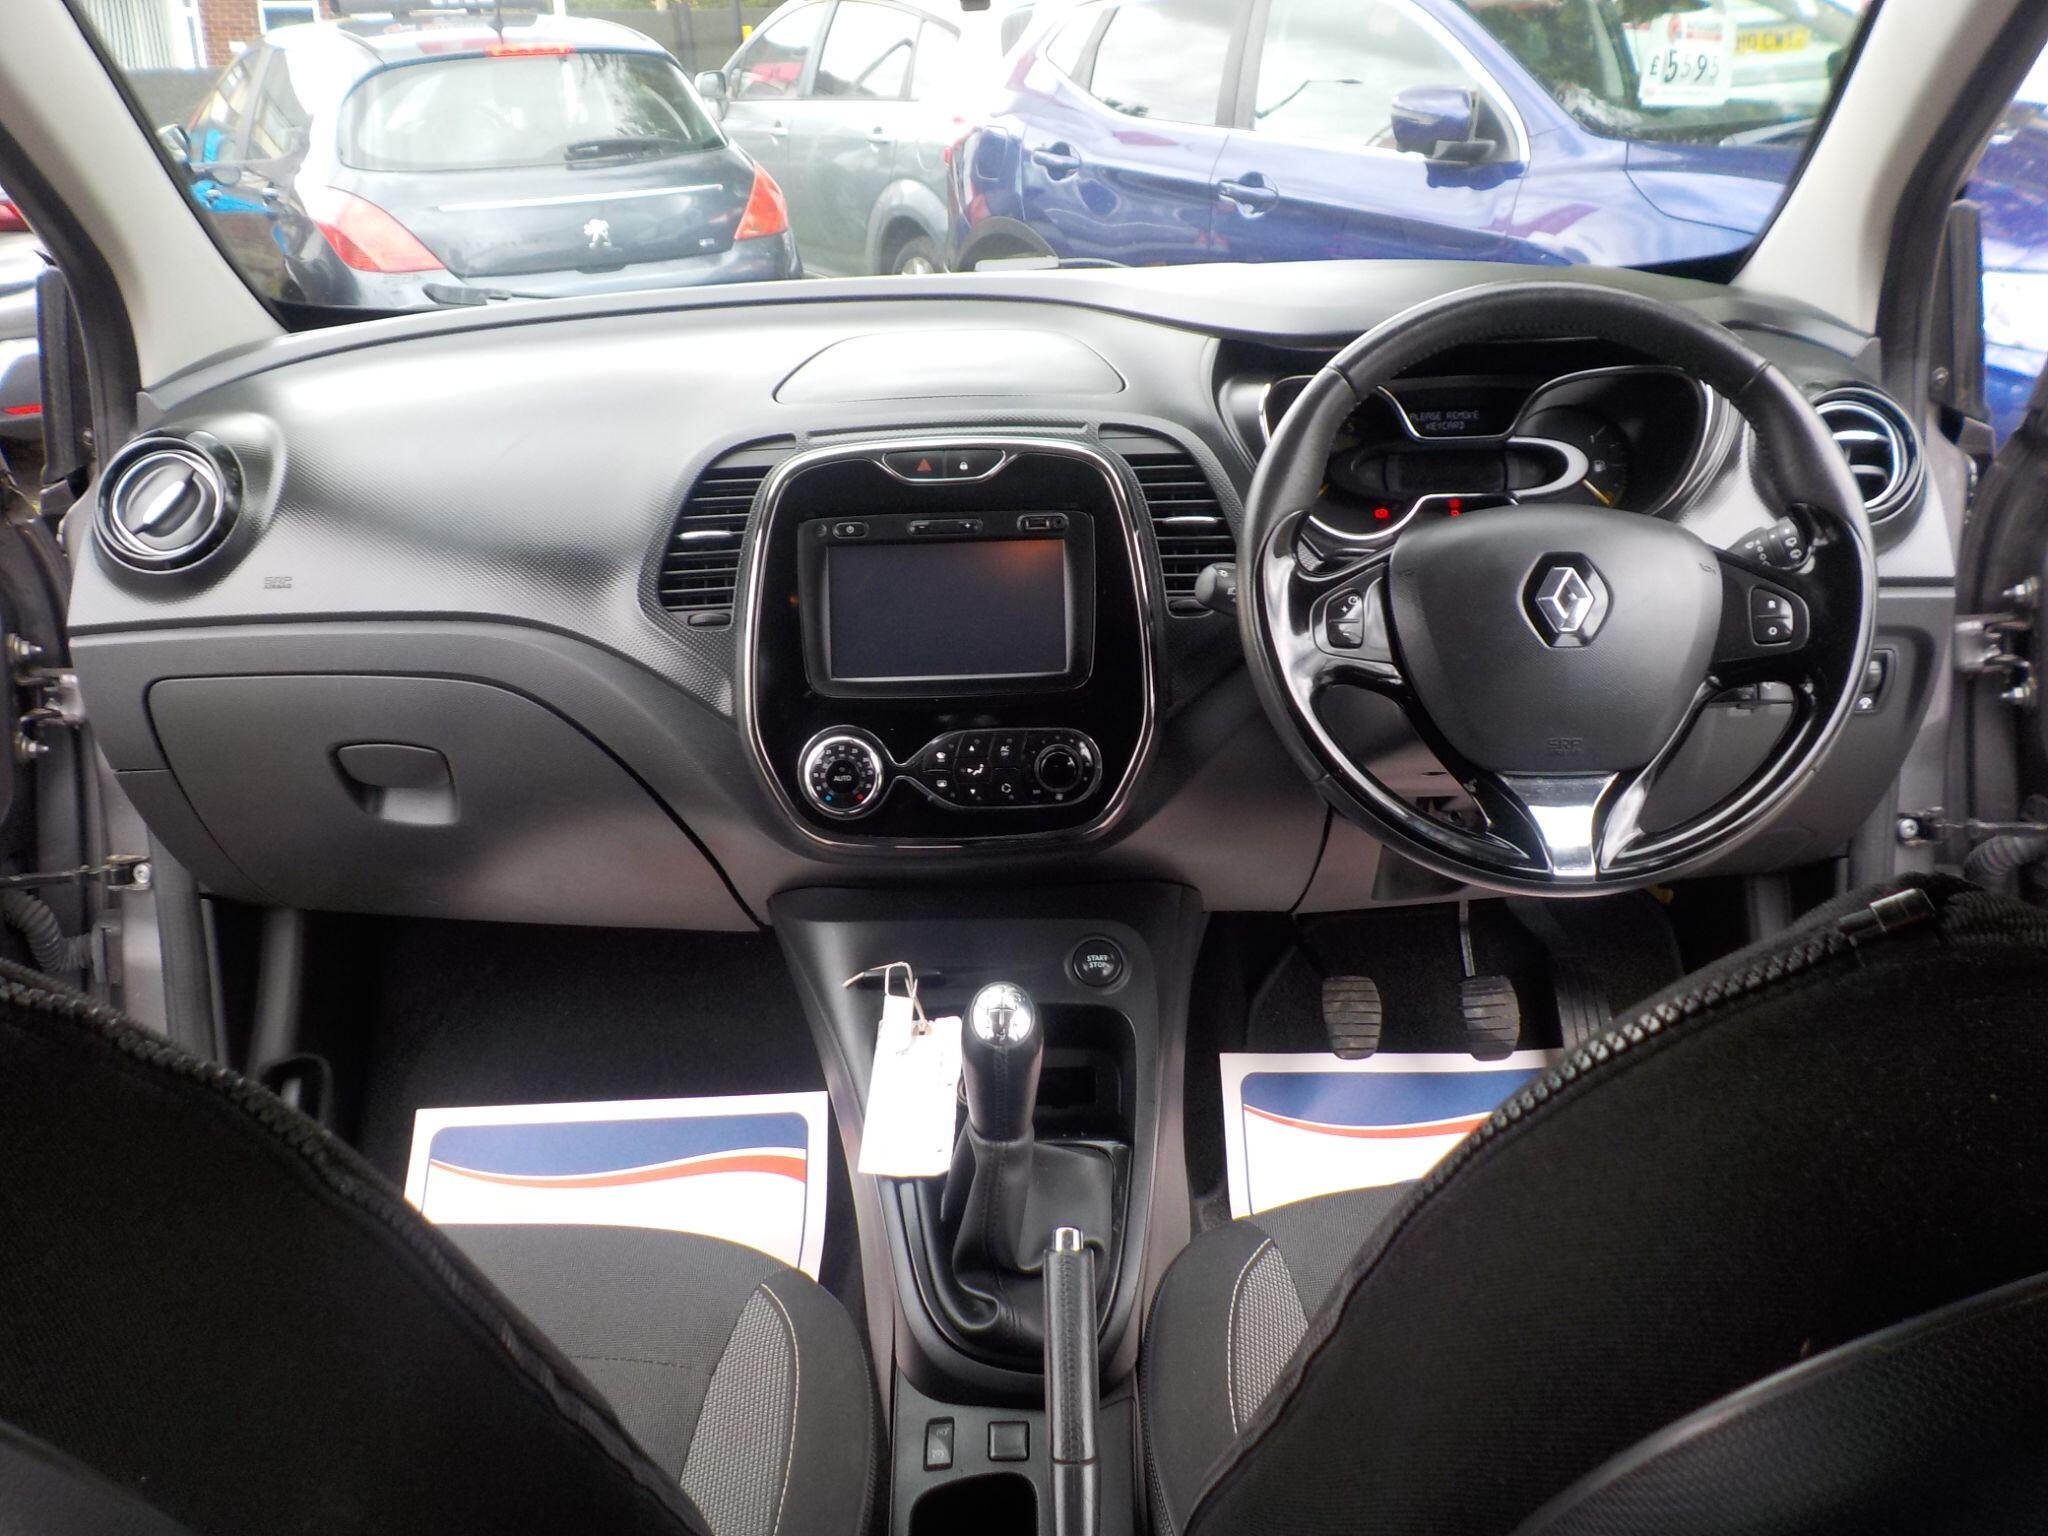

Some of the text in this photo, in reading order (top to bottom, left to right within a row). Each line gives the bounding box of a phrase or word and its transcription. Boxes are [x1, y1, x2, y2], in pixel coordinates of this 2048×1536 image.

[833, 774, 853, 782] AUTO
[1086, 954, 1109, 962] START
[1088, 961, 1110, 969] STOP
